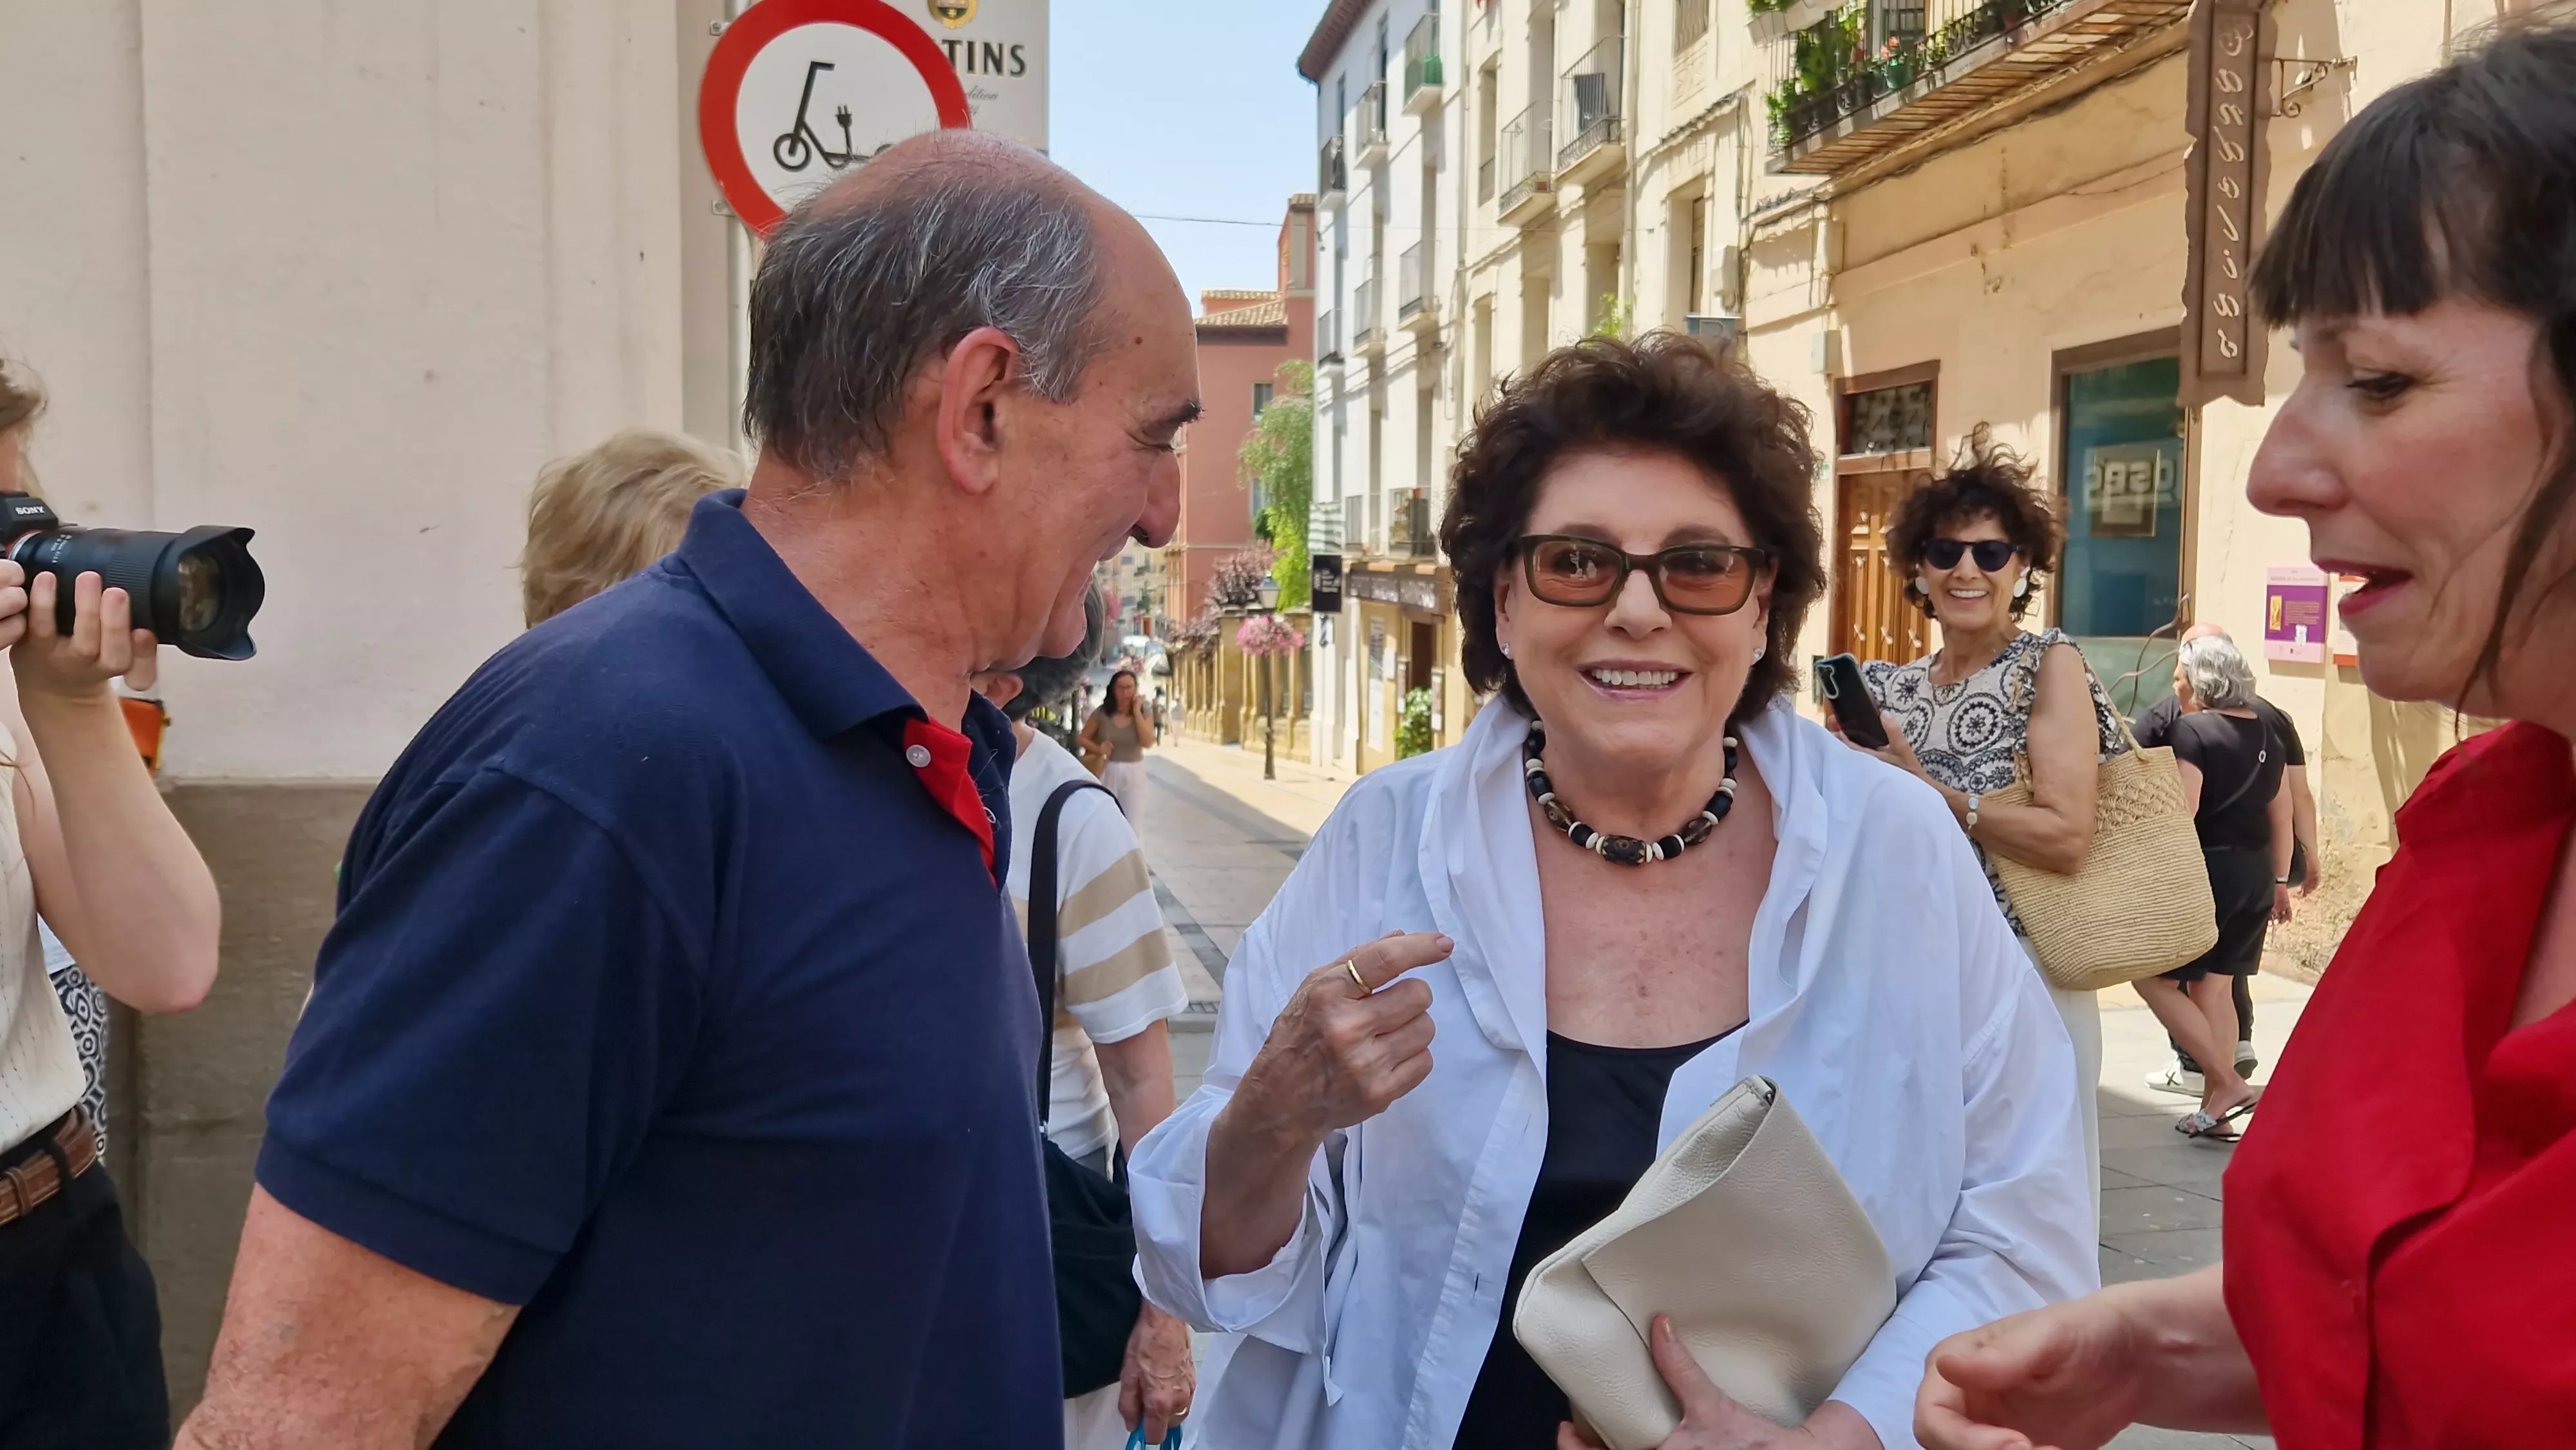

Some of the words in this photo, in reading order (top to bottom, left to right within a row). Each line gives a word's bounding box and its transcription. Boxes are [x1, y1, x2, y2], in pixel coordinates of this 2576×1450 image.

[940, 39, 1027, 78] TINS
[965, 85, 998, 100] dition
[15, 505, 45, 515] SONY
